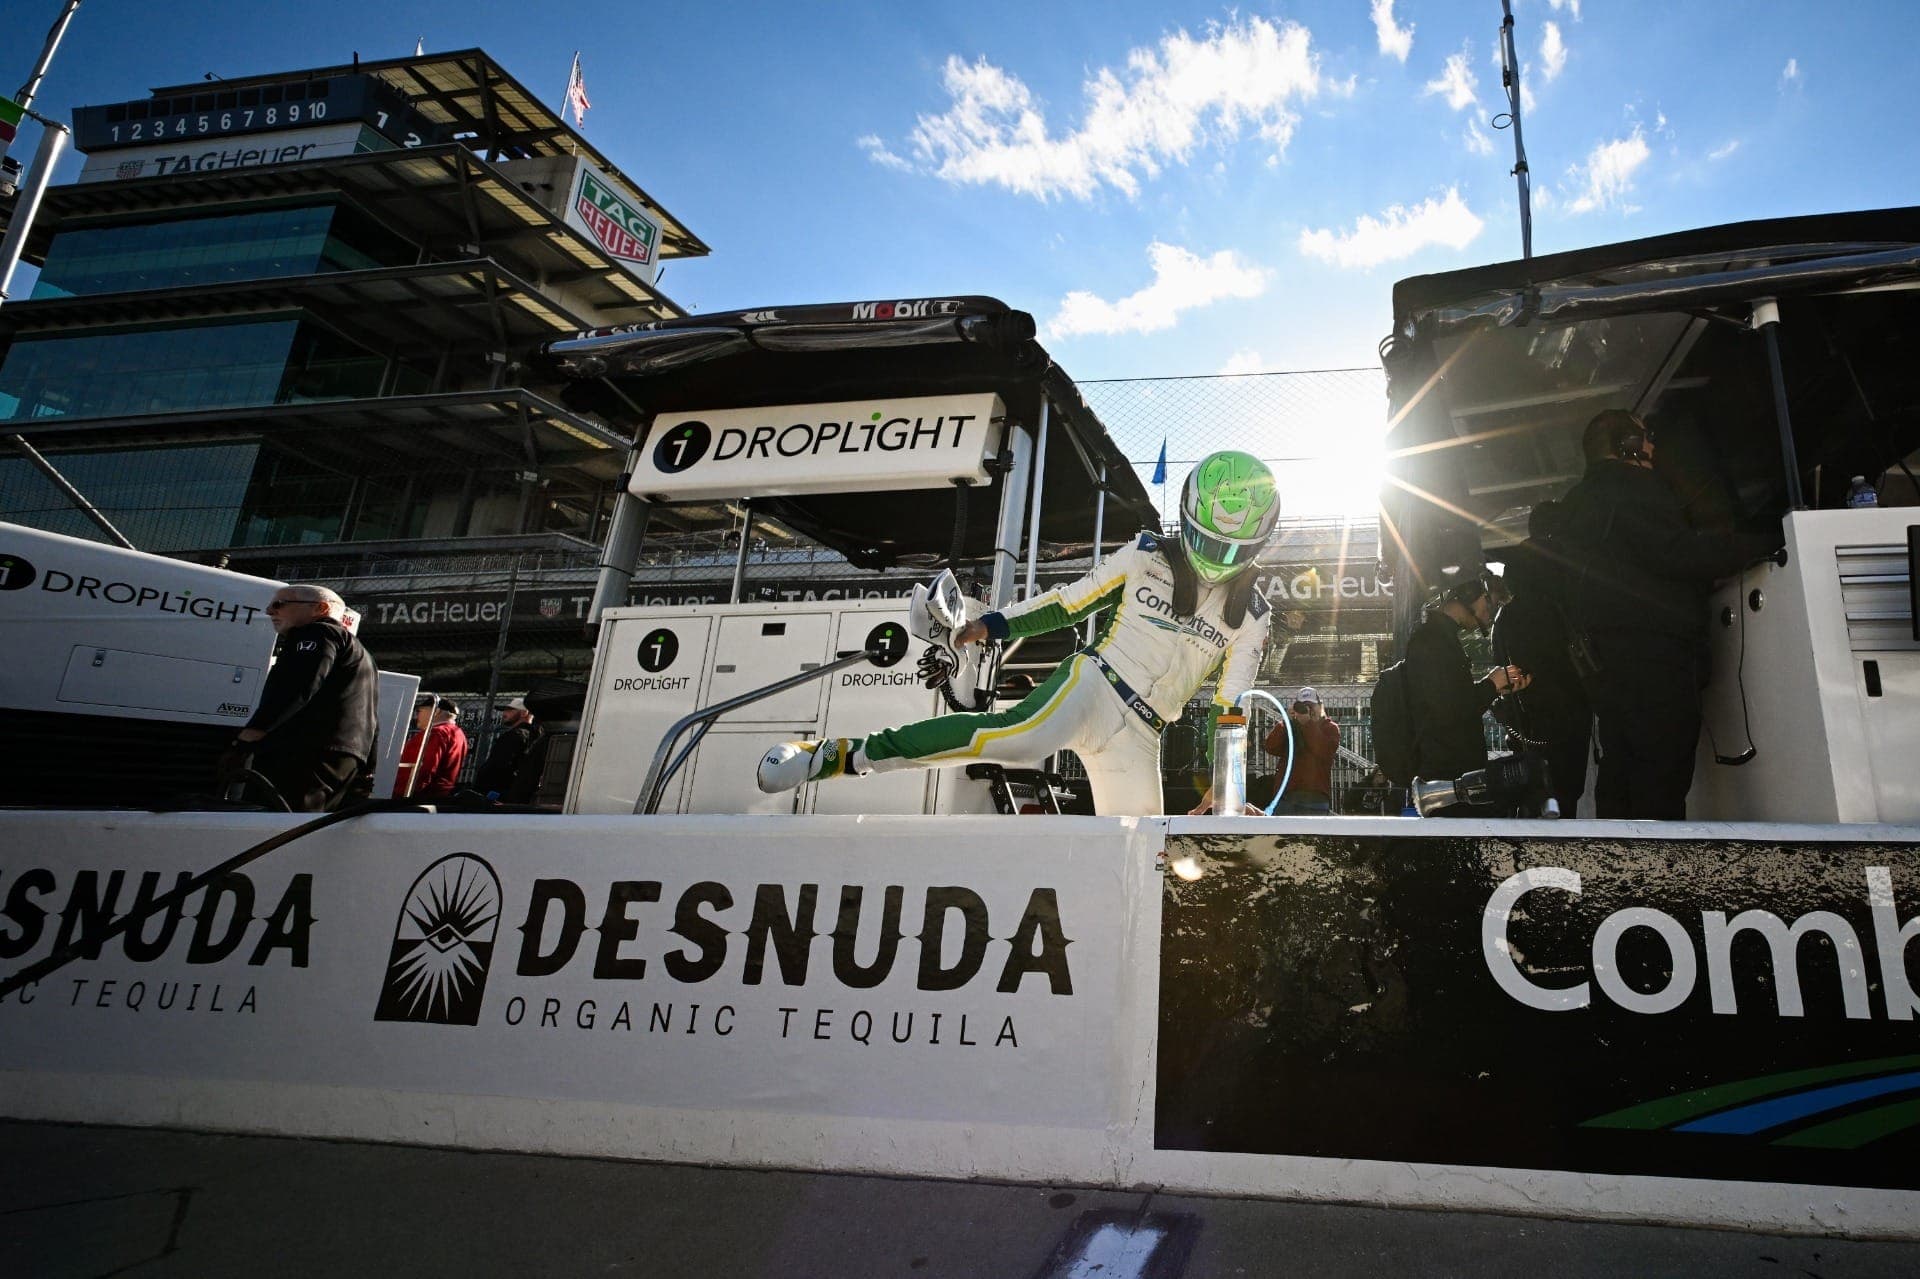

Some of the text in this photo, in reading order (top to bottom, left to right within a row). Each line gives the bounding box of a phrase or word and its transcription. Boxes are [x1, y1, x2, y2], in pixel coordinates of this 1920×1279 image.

[111, 101, 326, 142] 1 2 3 4 5 6 7 8 9 10
[376, 111, 388, 128] 1
[582, 202, 645, 257] HEUER
[590, 181, 647, 241] TAG
[852, 300, 930, 319] Mobil
[377, 602, 507, 623] TAGHeuer
[0, 868, 319, 968] SNUDA
[515, 878, 1073, 996] DESNUDA
[70, 979, 258, 1013] TEQUILA
[504, 996, 1018, 1048] ORGANIC TEQUILA
